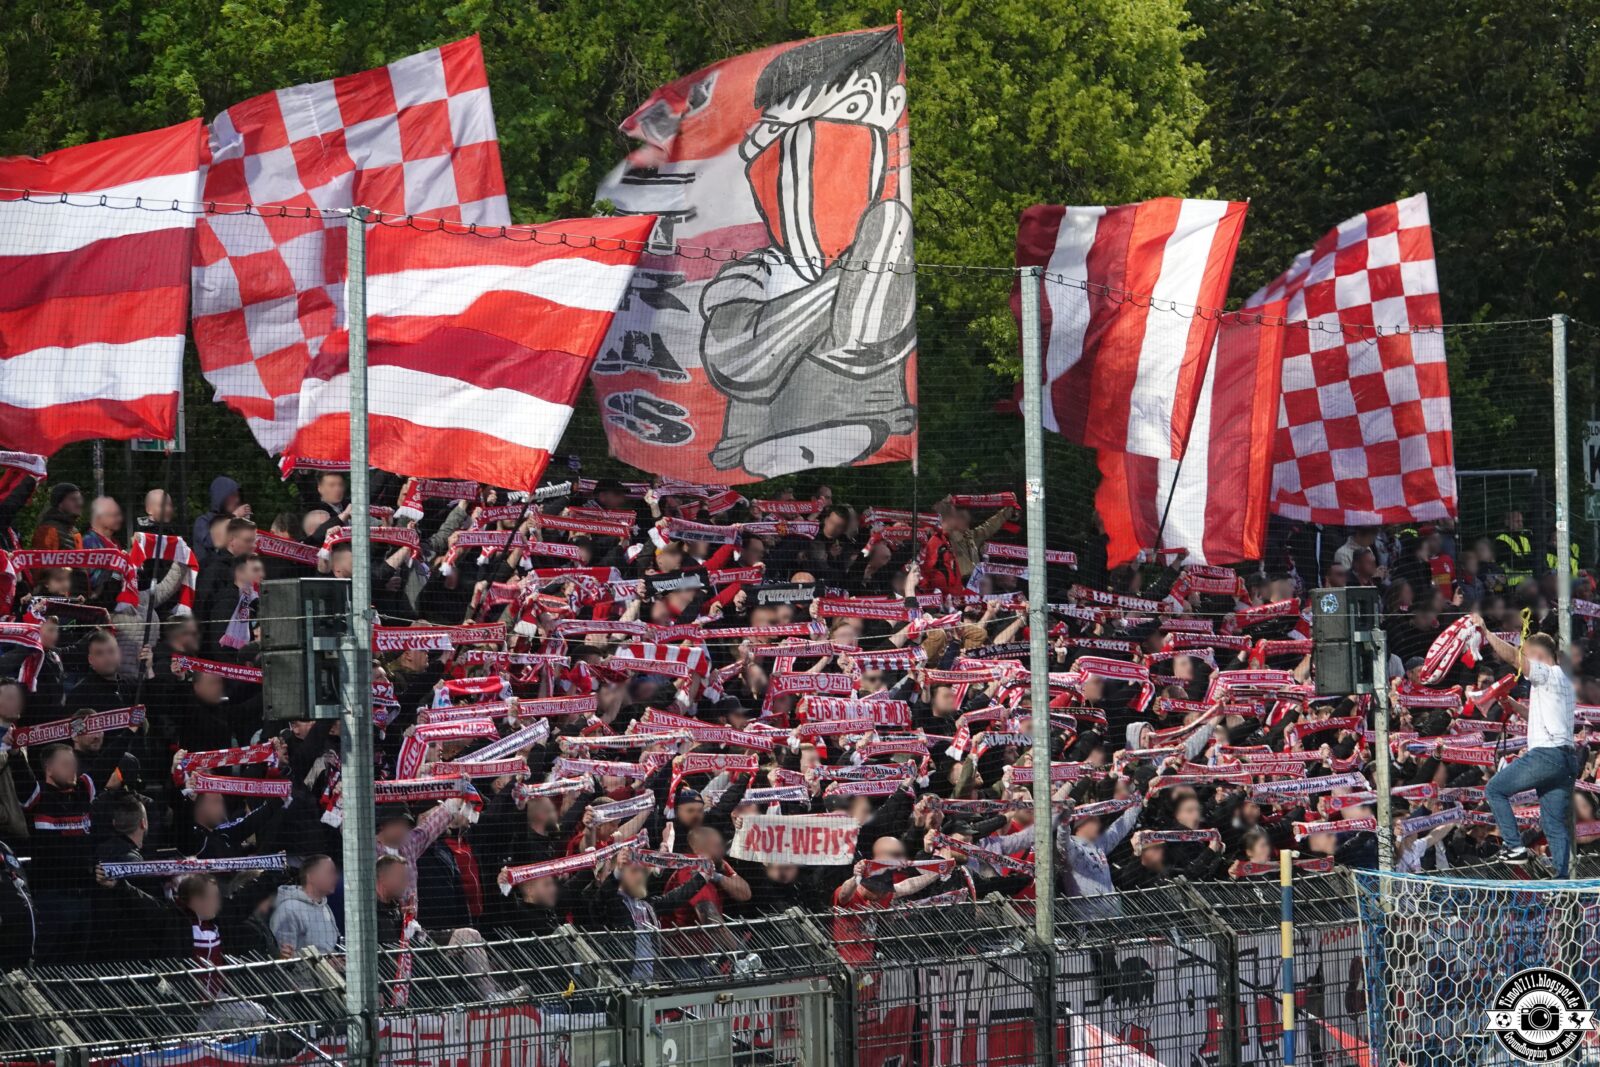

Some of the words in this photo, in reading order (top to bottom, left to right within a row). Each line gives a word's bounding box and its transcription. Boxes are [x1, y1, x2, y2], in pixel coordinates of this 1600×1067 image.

[12, 553, 84, 569] ROT-WEISS
[87, 553, 133, 572] ERFURT
[375, 782, 455, 797] üringenterror
